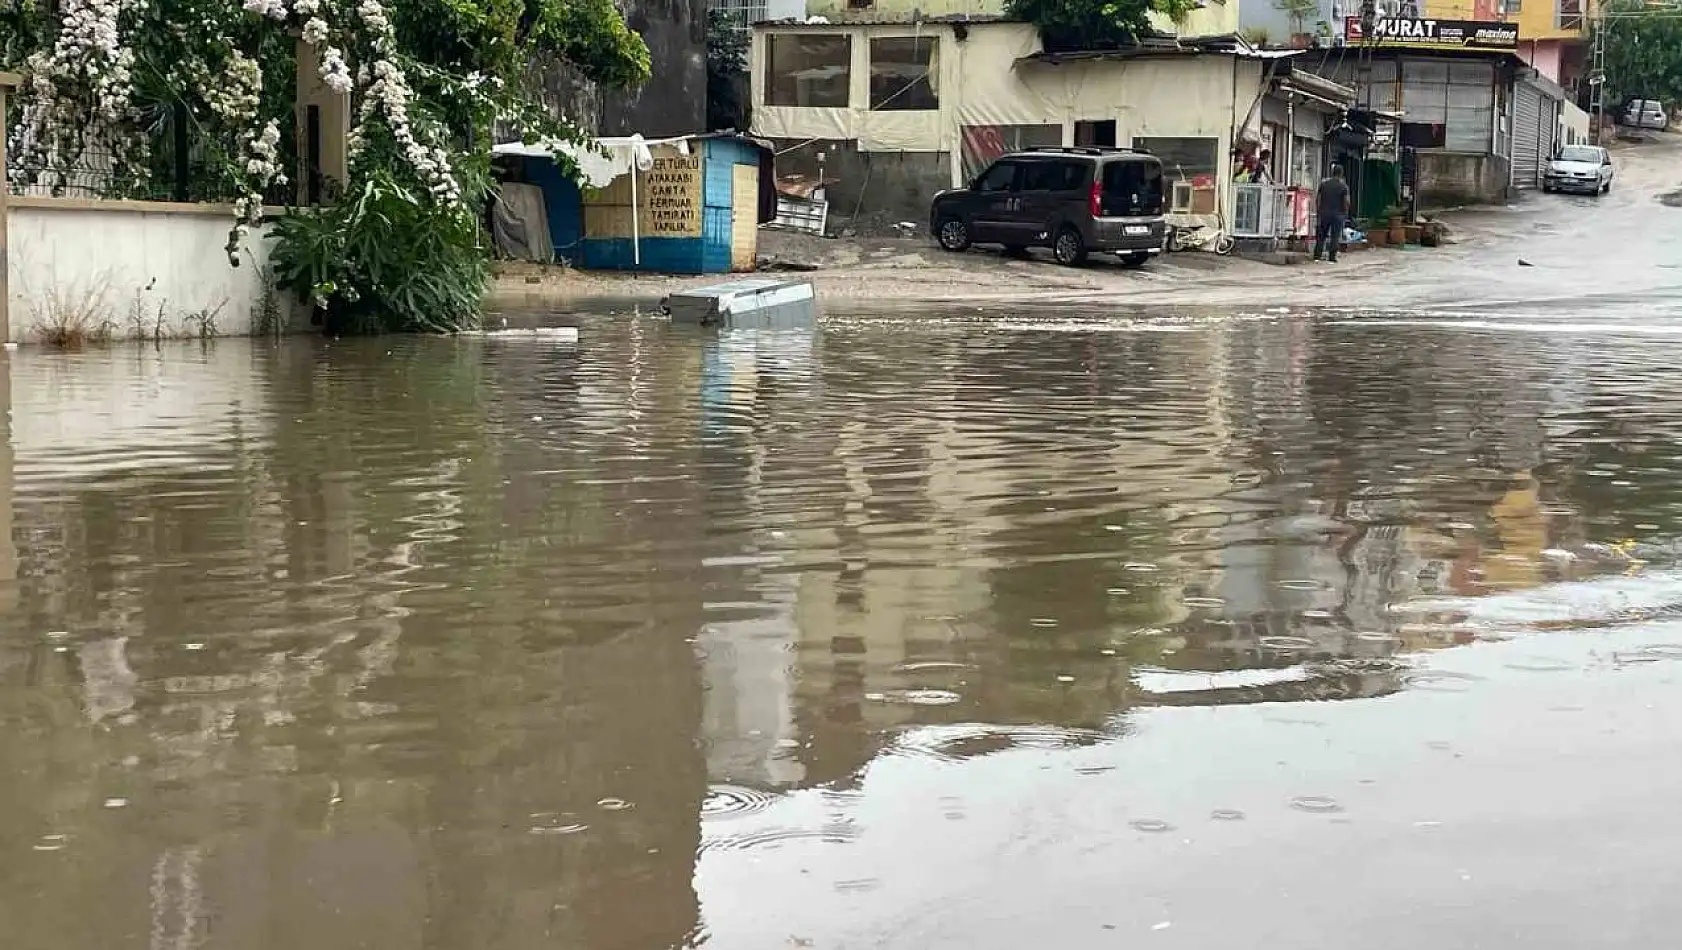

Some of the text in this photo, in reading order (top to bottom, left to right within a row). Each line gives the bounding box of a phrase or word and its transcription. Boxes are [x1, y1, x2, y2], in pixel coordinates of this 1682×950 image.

[1373, 19, 1436, 37] MURAT
[651, 157, 666, 169] ER
[650, 197, 692, 208] FERMUAR
